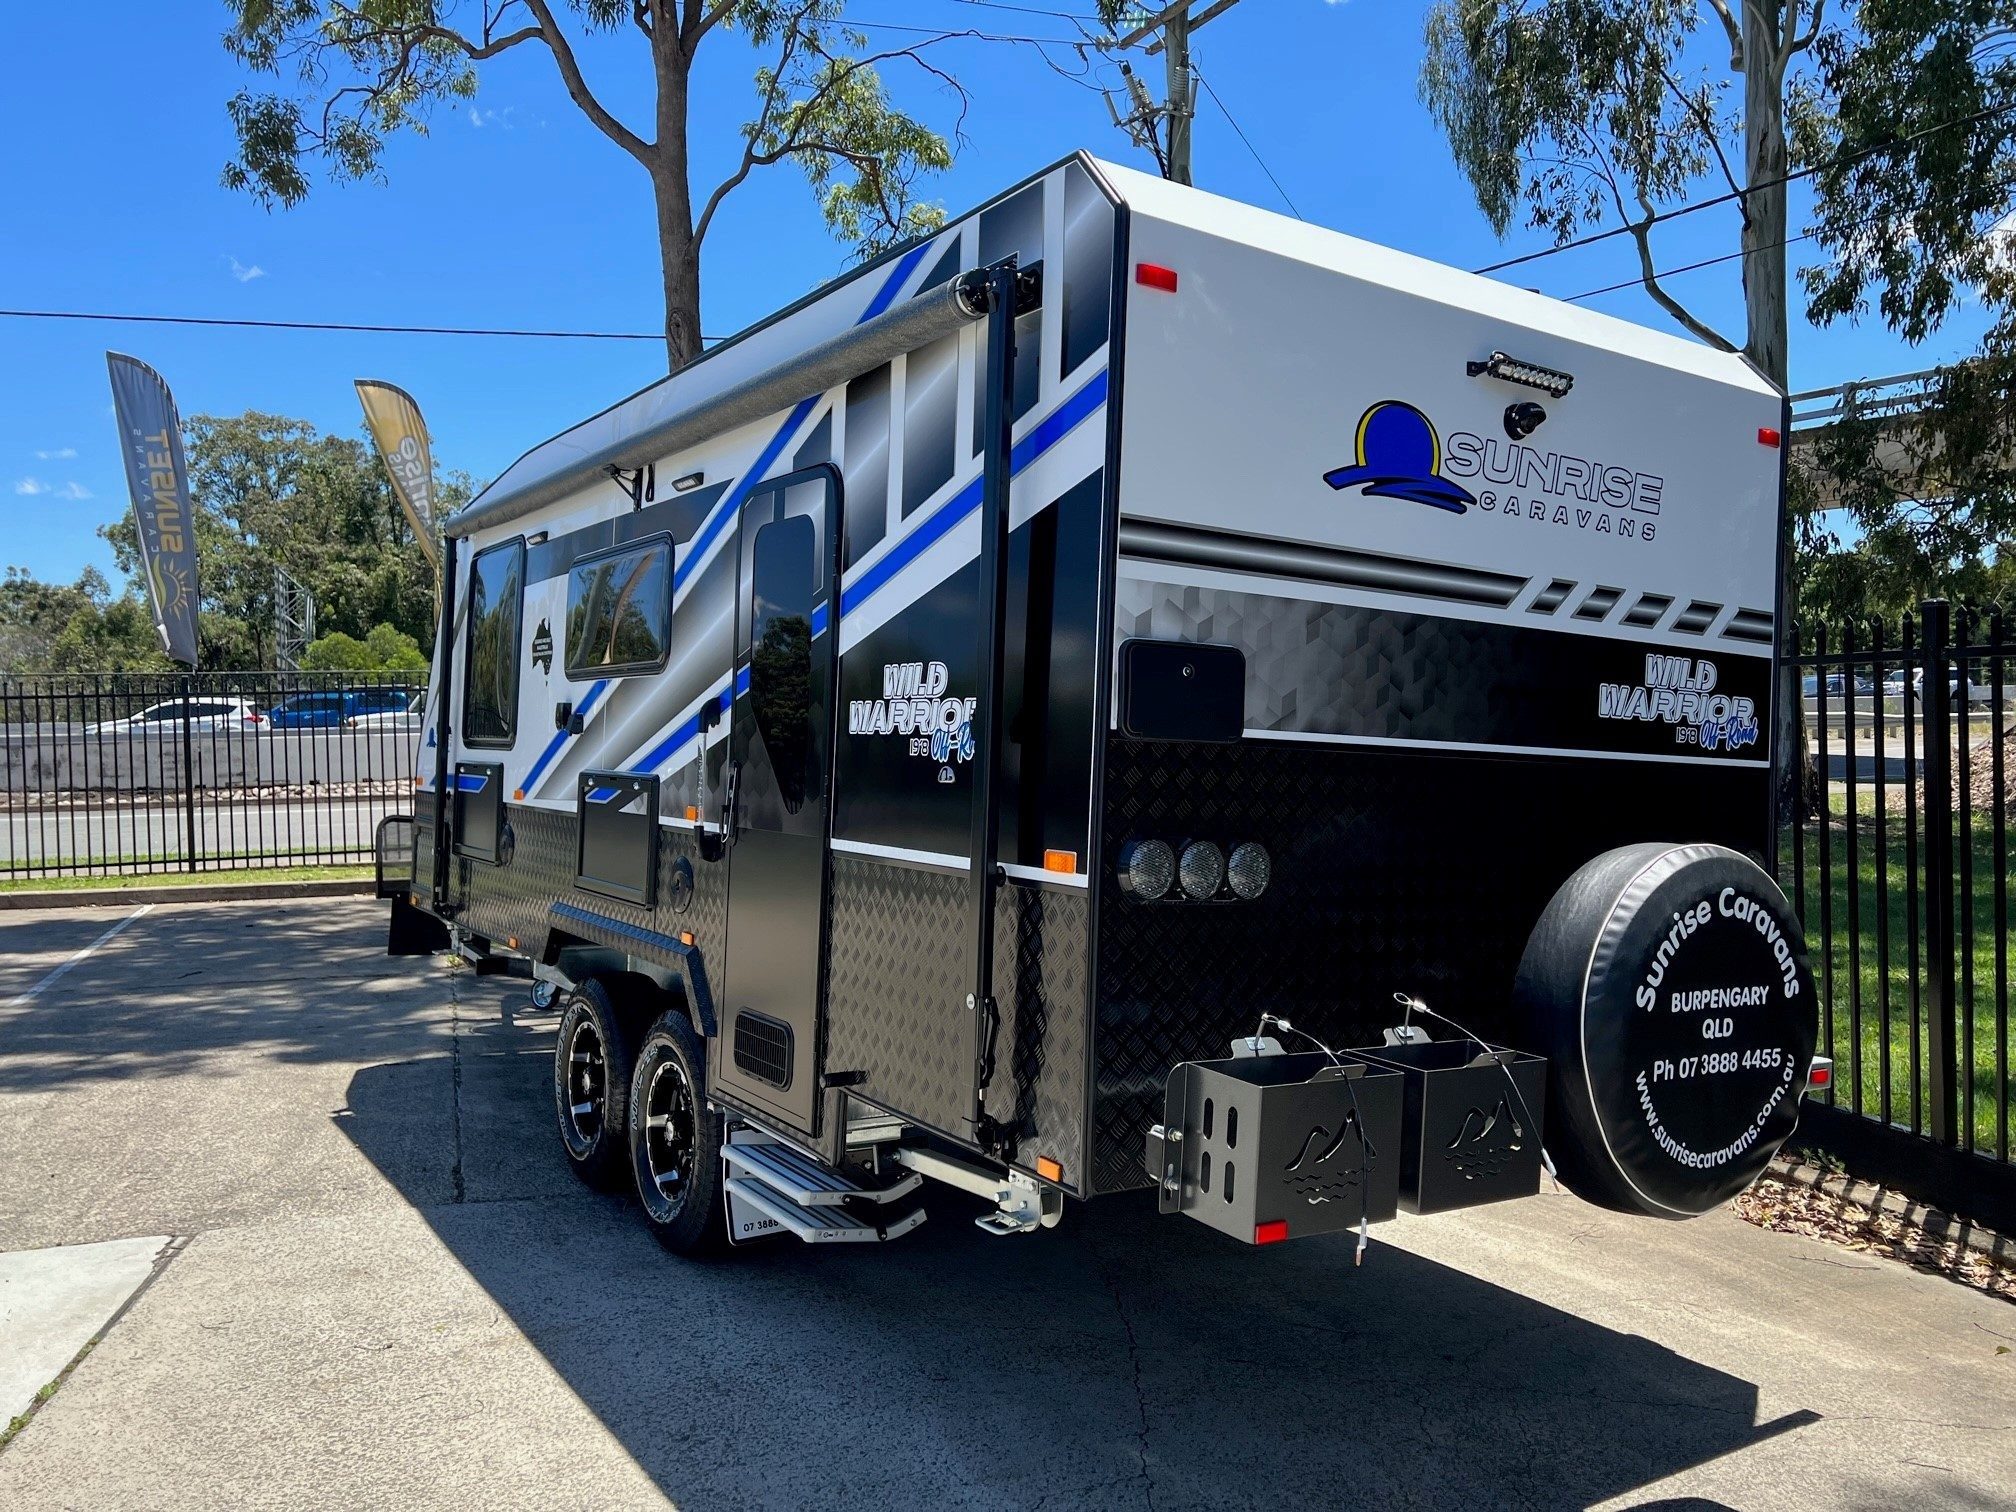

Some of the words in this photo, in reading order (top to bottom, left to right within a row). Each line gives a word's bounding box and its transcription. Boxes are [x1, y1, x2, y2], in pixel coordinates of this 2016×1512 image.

[1444, 431, 1664, 515] SUNRISE
[1479, 491, 1656, 541] CARAVANS
[883, 661, 949, 699] WILD
[1645, 654, 1717, 692] WILD
[1598, 683, 1754, 727] WARRIOR
[1636, 901, 1711, 1012] Sunrise
[1719, 887, 1799, 999] Caravans
[1671, 986, 1769, 1013] BURPENGARY
[1702, 1018, 1733, 1039] QLD
[1653, 1060, 1674, 1082] Ph
[1679, 1057, 1699, 1078] 07
[1701, 1052, 1738, 1075] 3888
[1742, 1048, 1781, 1069] 4455
[1636, 1054, 1795, 1168] www.sunrisecaravans.com.au
[743, 1222, 755, 1232] 07
